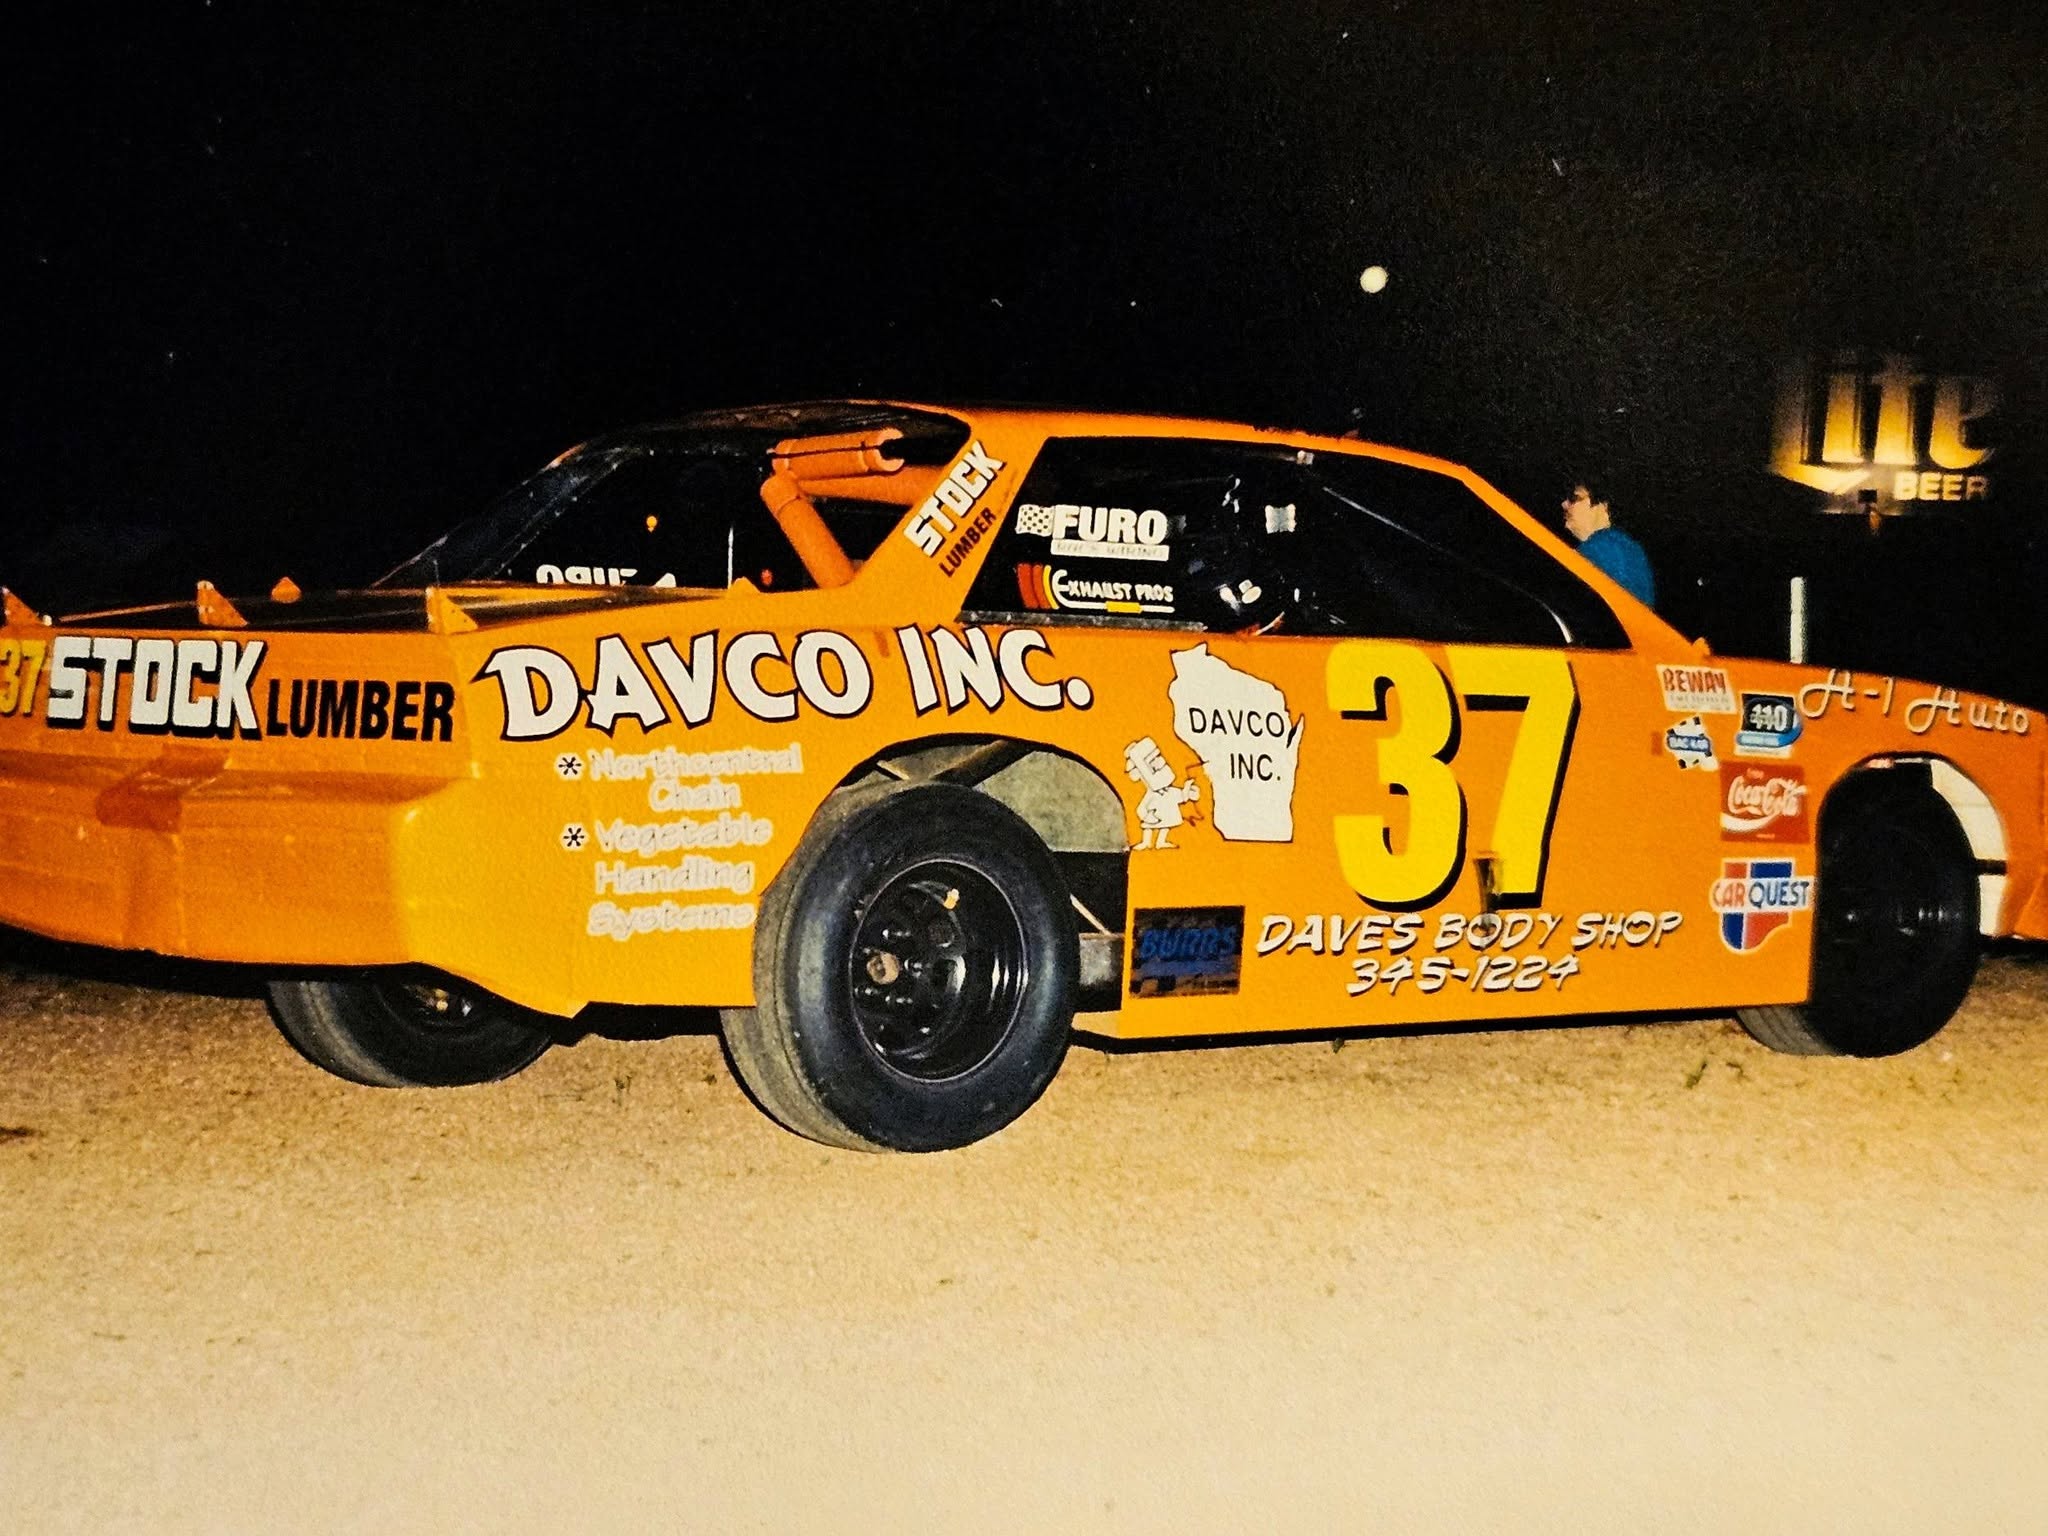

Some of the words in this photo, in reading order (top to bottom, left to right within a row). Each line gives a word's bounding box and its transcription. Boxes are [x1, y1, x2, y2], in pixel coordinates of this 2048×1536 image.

[903, 440, 1007, 558] STOCK
[1893, 471, 1989, 501] BEER
[939, 507, 996, 577] LUMBER
[1052, 505, 1168, 545] FURO
[0, 639, 47, 717] 37
[47, 636, 267, 739] STOCK
[267, 678, 454, 741] LUMBER
[468, 629, 873, 741] DAVCO
[895, 624, 1094, 717] INC.
[1189, 707, 1286, 738] DAVCO
[1230, 752, 1281, 782] INC.
[1325, 639, 1581, 911] 37
[648, 777, 741, 812] Chain
[595, 812, 773, 857] Vegetable
[595, 855, 754, 894] Handling
[586, 900, 757, 942] Systems
[1255, 913, 1425, 956] DAVES
[1434, 912, 1562, 952] BODY
[1570, 911, 1684, 949] SHOP
[1345, 952, 1580, 997] 345-1224
